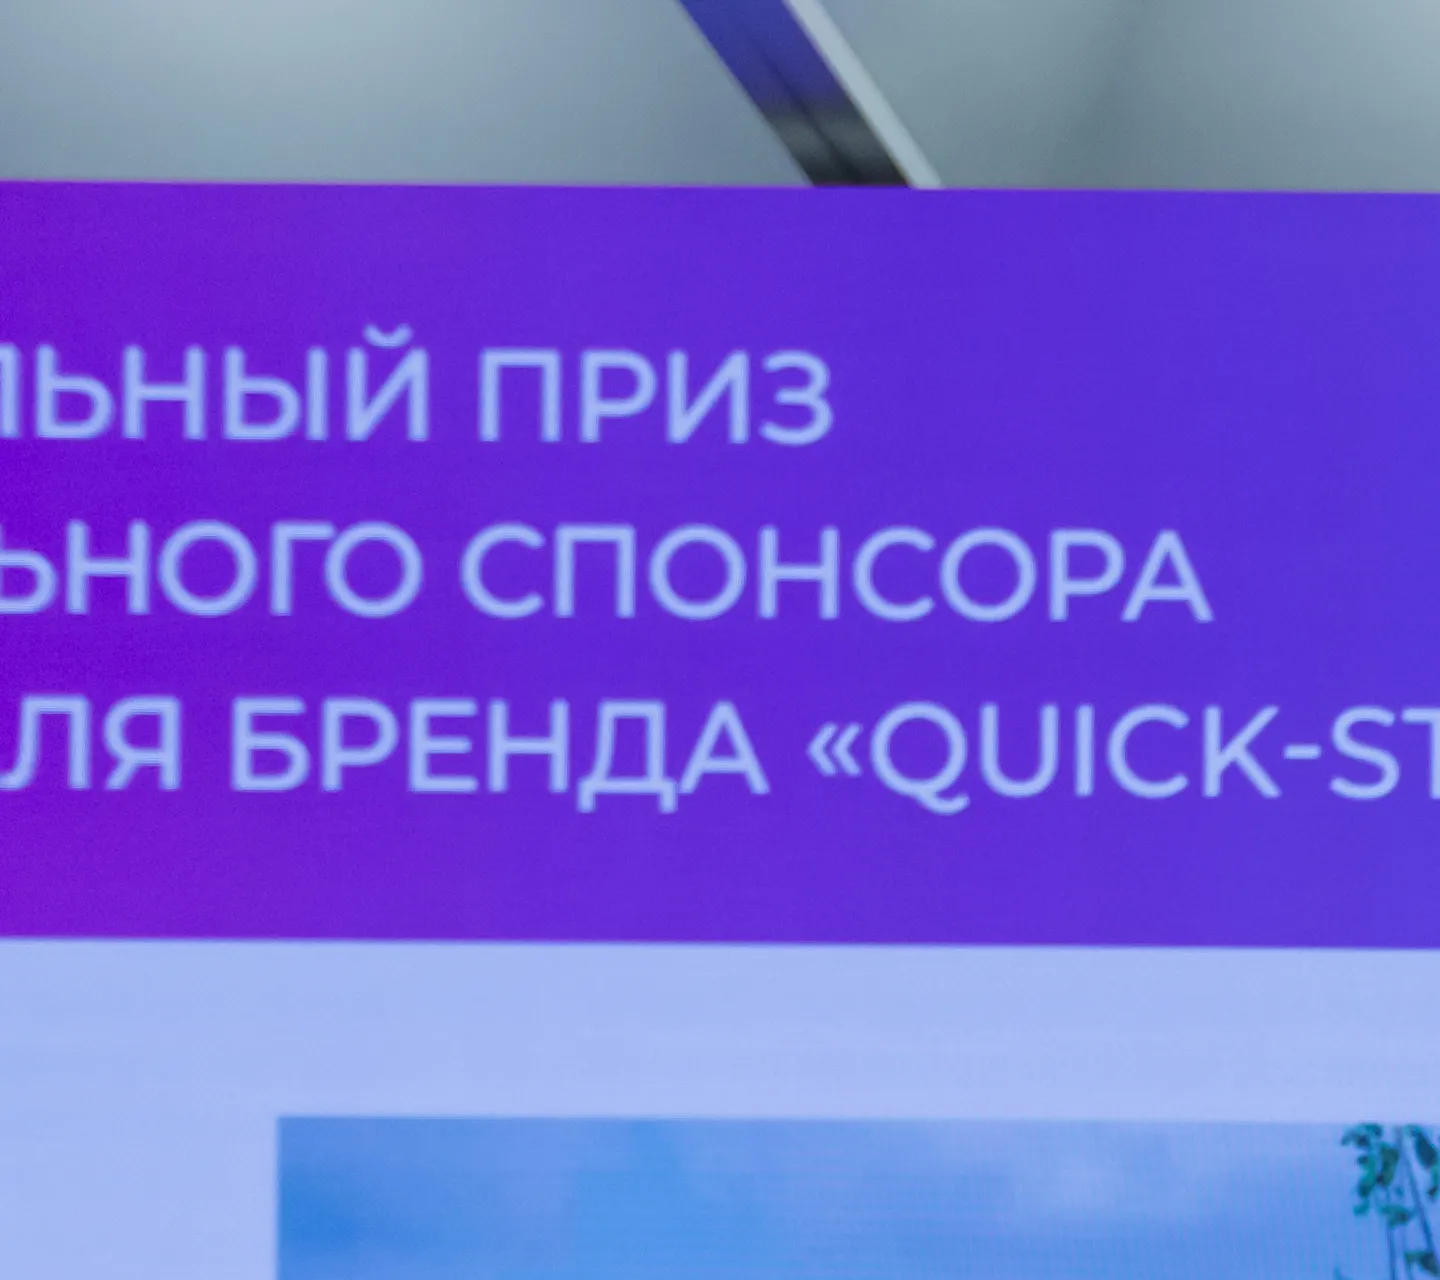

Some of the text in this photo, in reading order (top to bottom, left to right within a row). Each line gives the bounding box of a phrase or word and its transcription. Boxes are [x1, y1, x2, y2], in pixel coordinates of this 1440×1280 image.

[0, 326, 833, 446] ЬНЫЙ ПРИЗ
[461, 523, 1213, 623] СПОНСОРА
[232, 697, 770, 814] БРЕНДА
